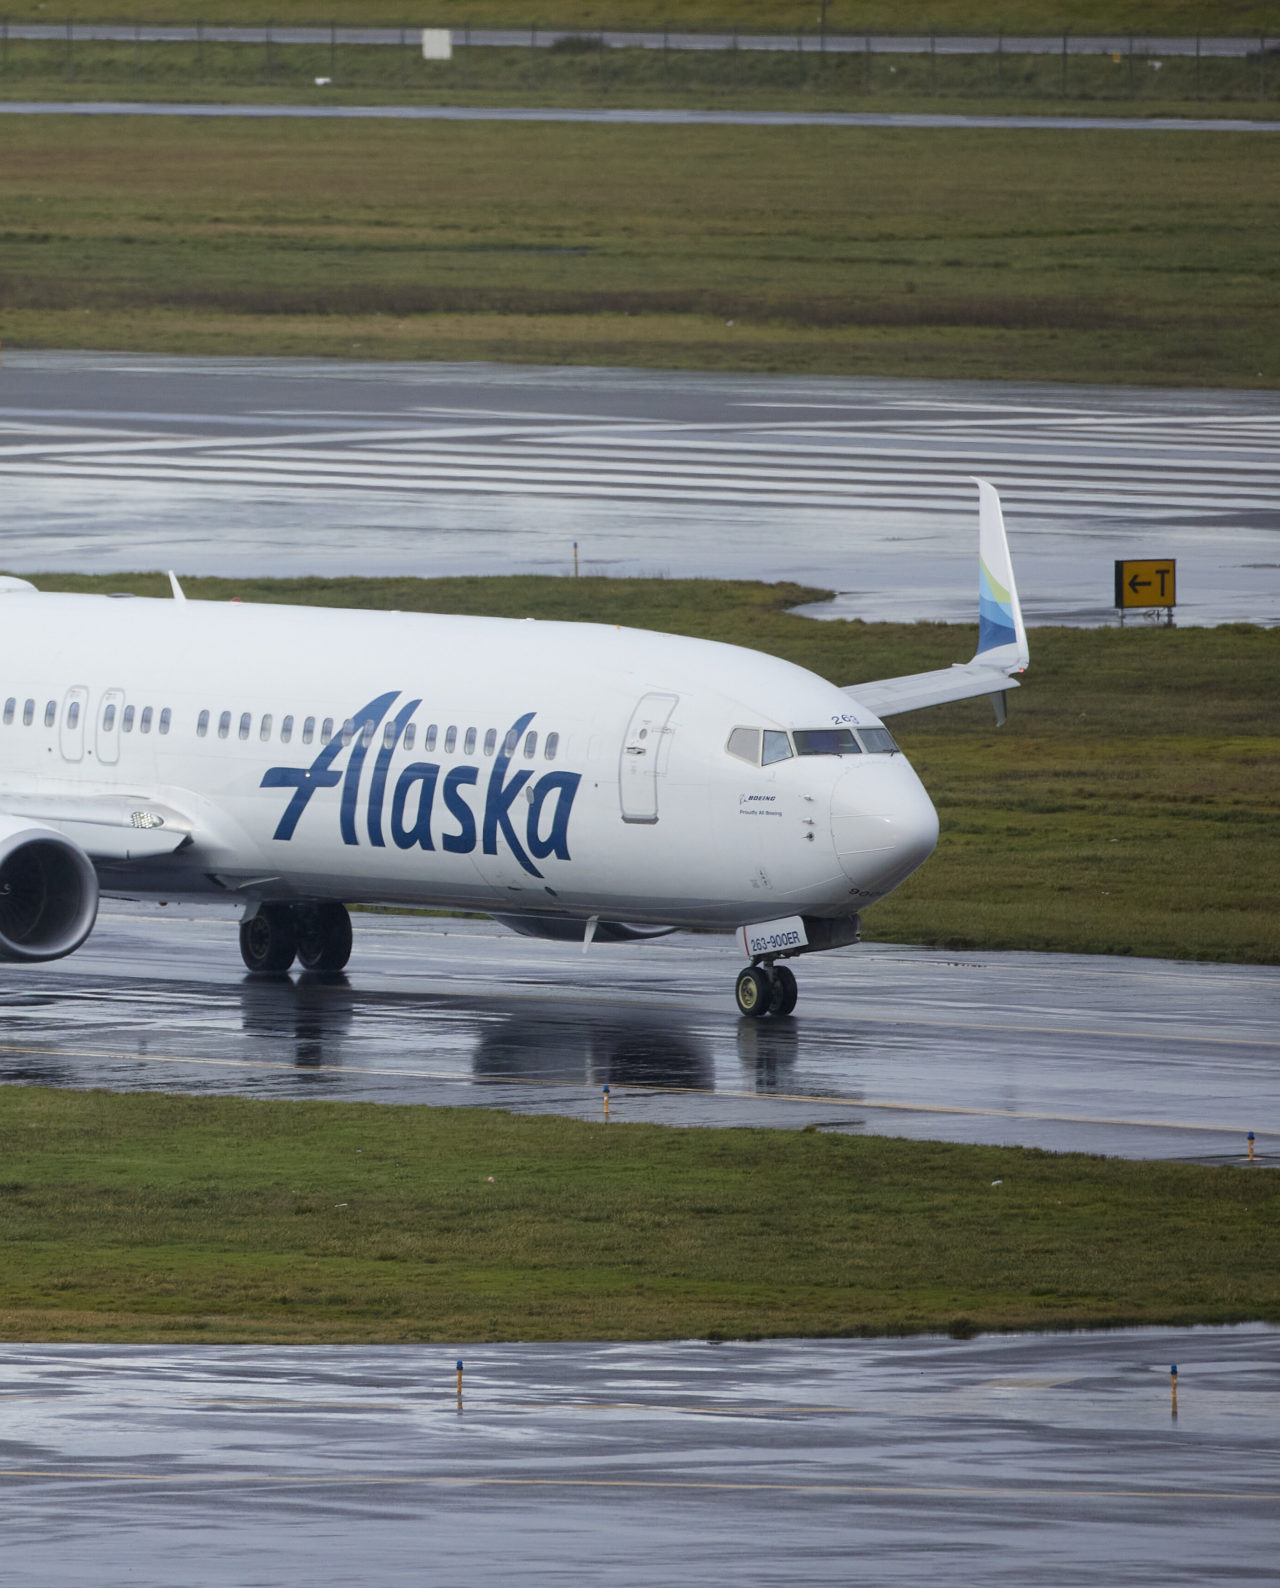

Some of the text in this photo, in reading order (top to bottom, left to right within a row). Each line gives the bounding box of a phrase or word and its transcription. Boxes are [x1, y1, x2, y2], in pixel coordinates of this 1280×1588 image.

[1155, 569, 1170, 597] T
[831, 714, 860, 725] 263
[260, 690, 583, 878] Alaska
[751, 931, 801, 952] 263-900ER
